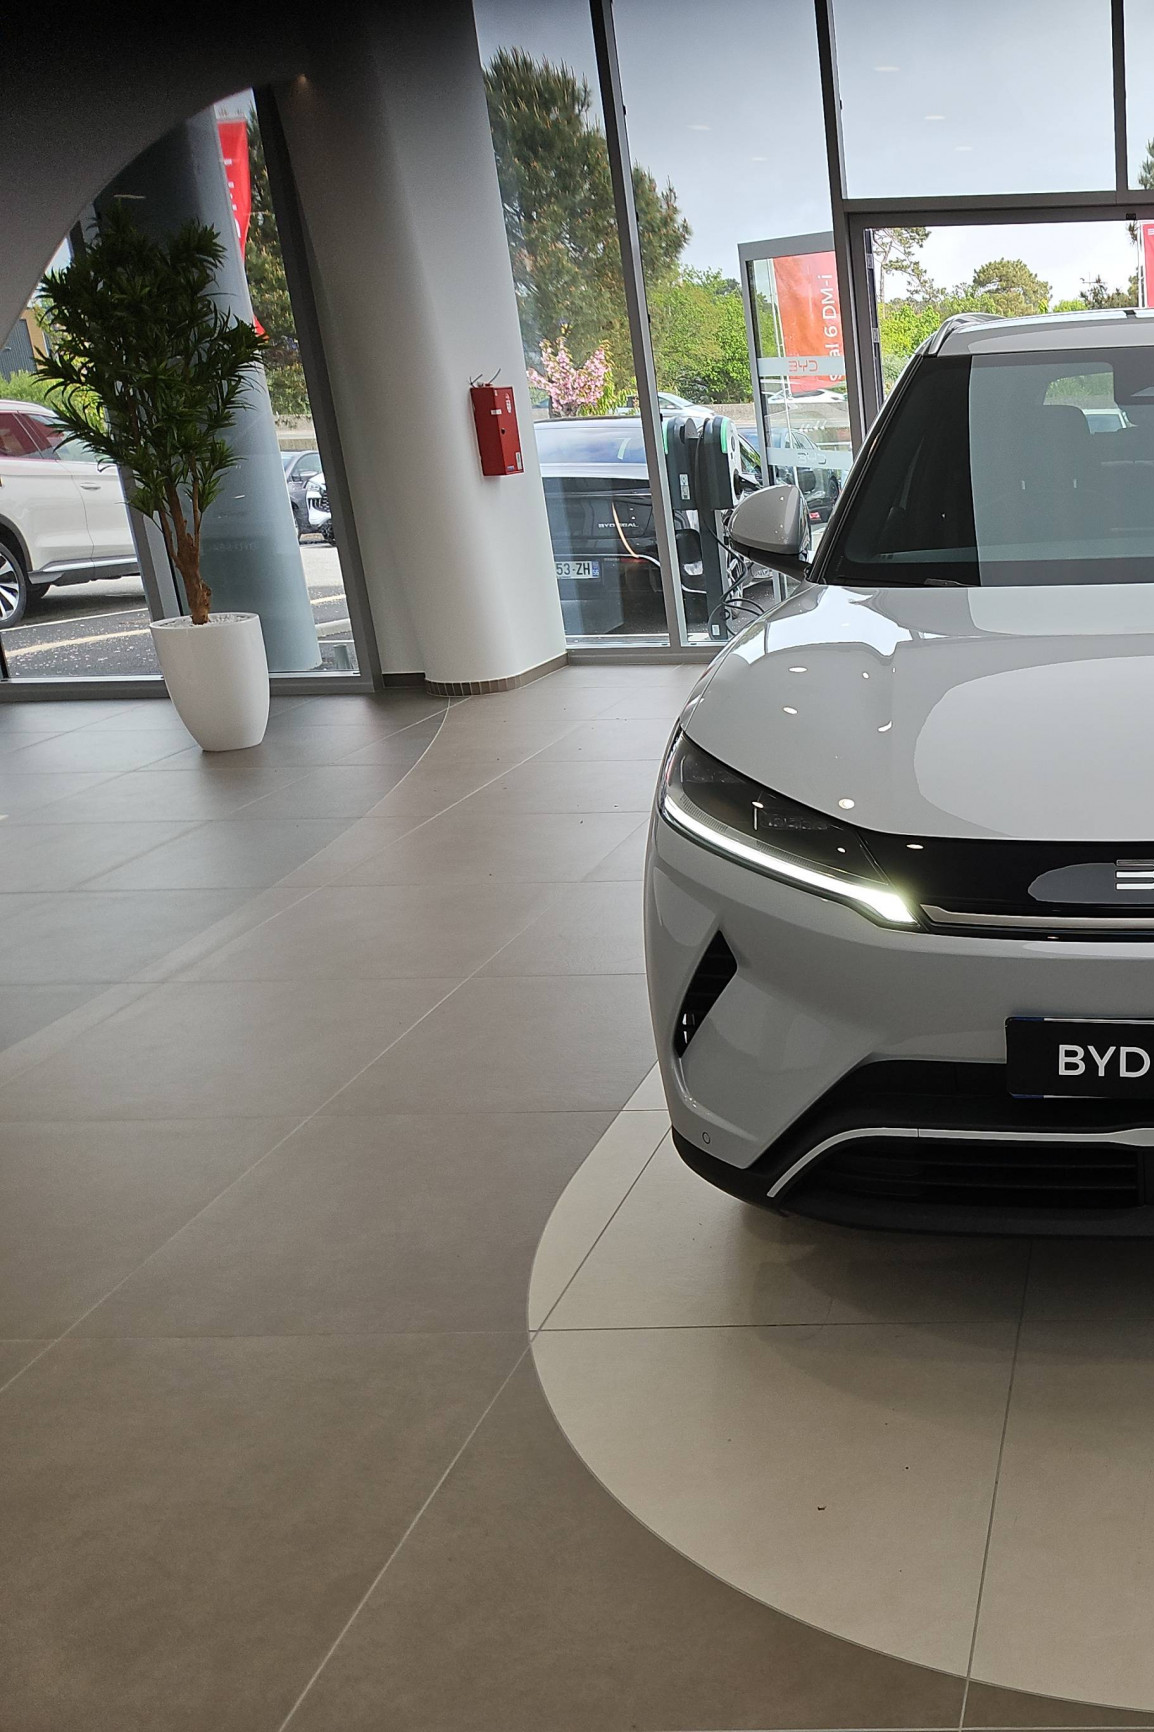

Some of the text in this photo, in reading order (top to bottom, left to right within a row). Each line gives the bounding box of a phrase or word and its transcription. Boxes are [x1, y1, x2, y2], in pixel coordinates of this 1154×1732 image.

[817, 274, 837, 319] DM-i
[823, 325, 838, 338] 6
[788, 360, 819, 372] BYD
[1057, 1044, 1151, 1078] BYD
